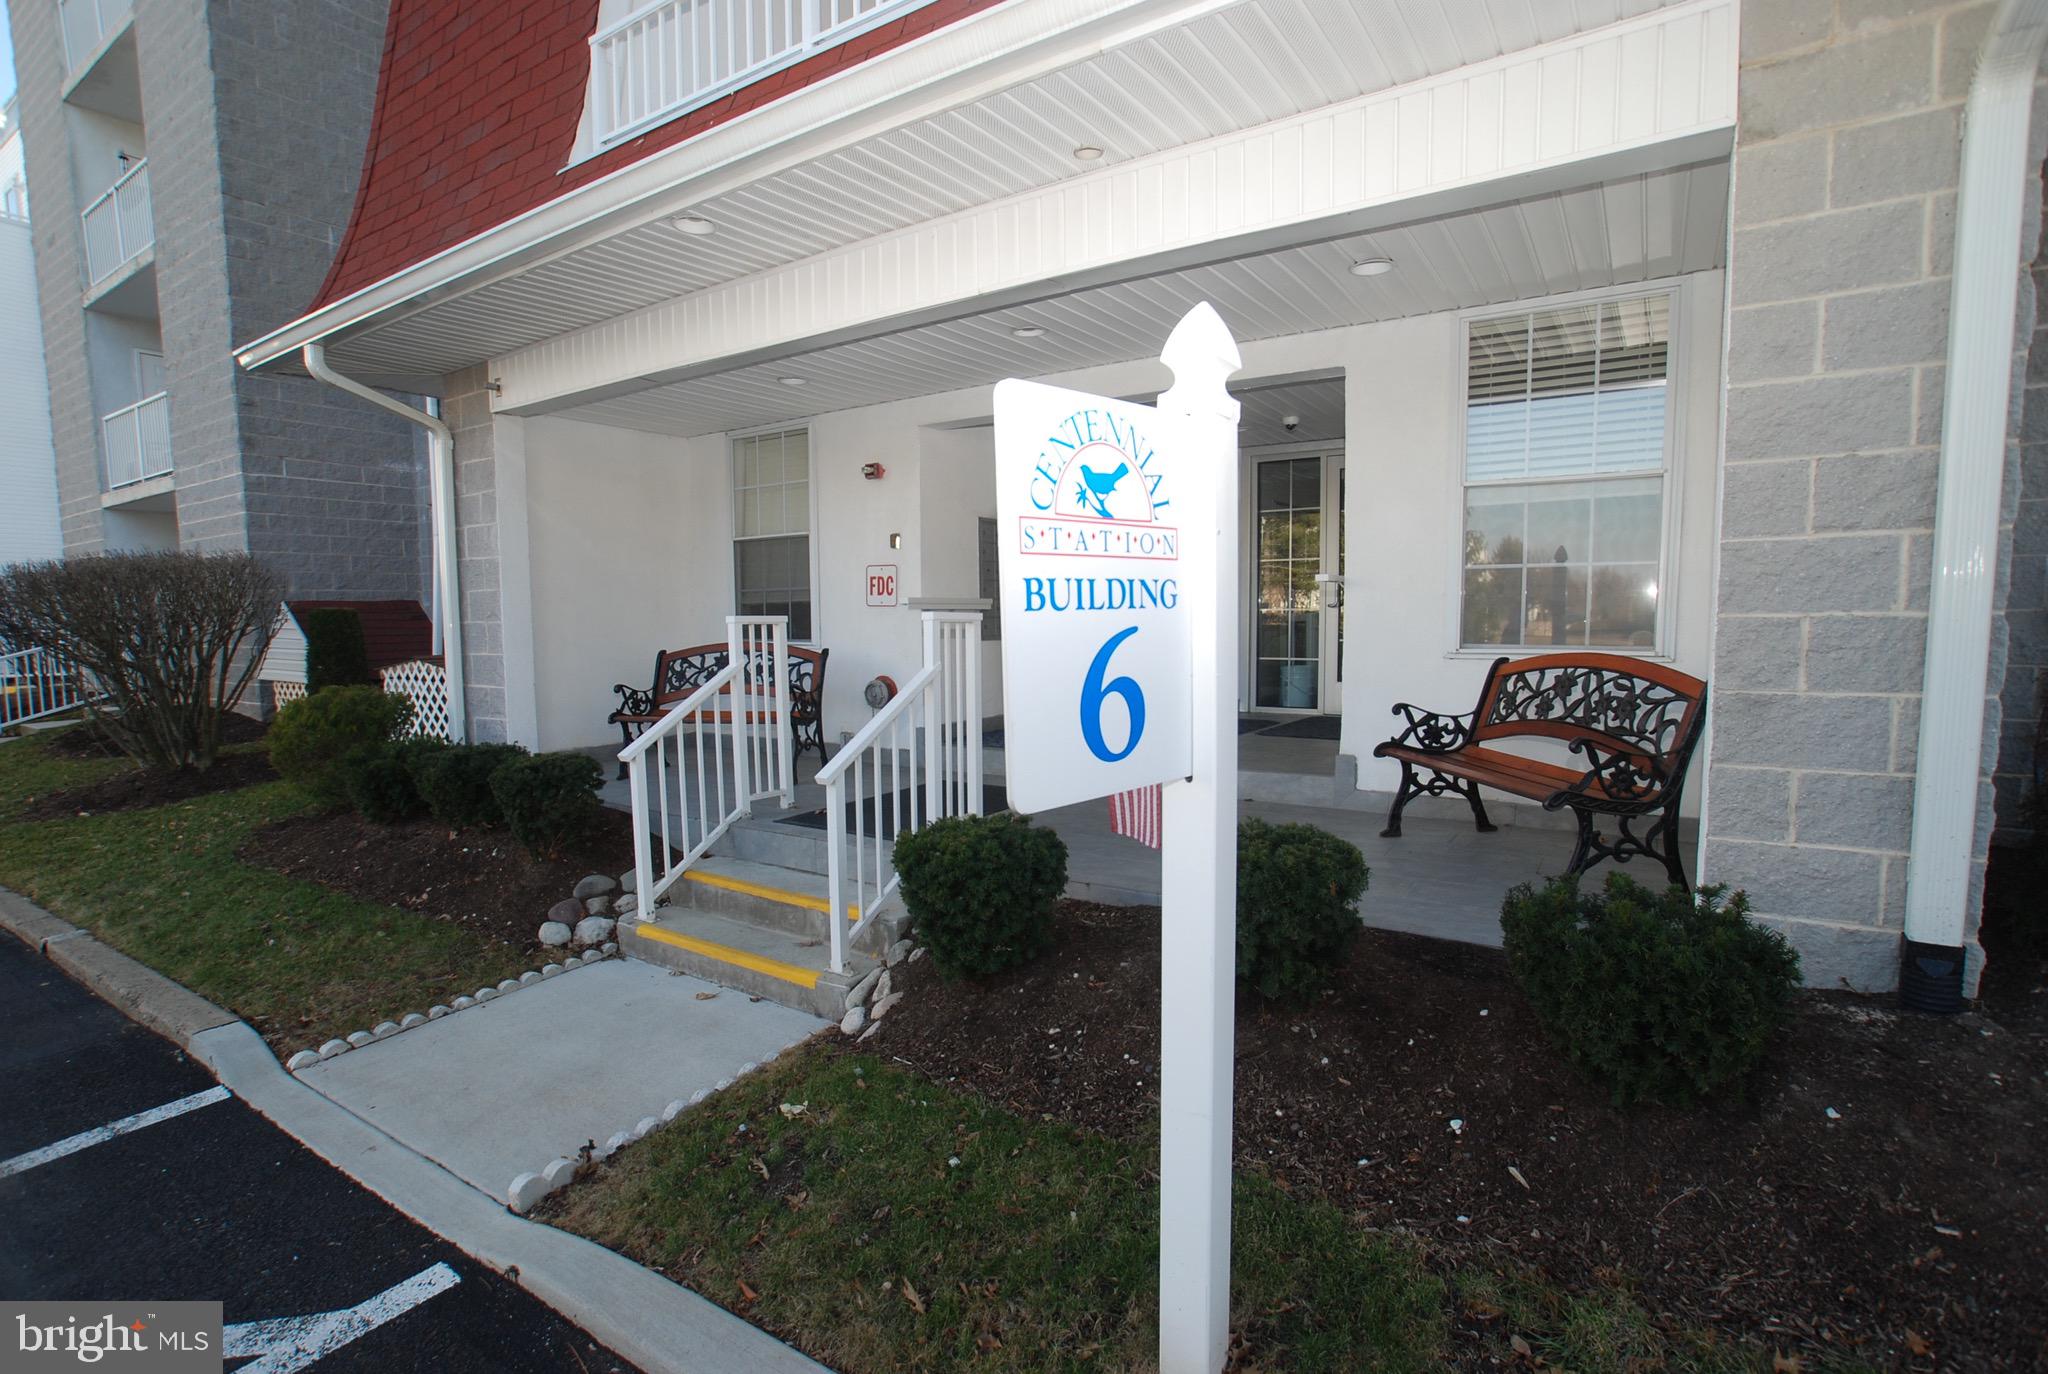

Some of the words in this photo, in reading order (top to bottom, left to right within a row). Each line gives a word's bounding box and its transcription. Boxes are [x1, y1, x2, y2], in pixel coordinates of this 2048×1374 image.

[1030, 409, 1170, 520] CENTENNIAL
[869, 575, 894, 597] FDC
[1023, 577, 1178, 612] BUILDING
[1080, 626, 1145, 762] 6
